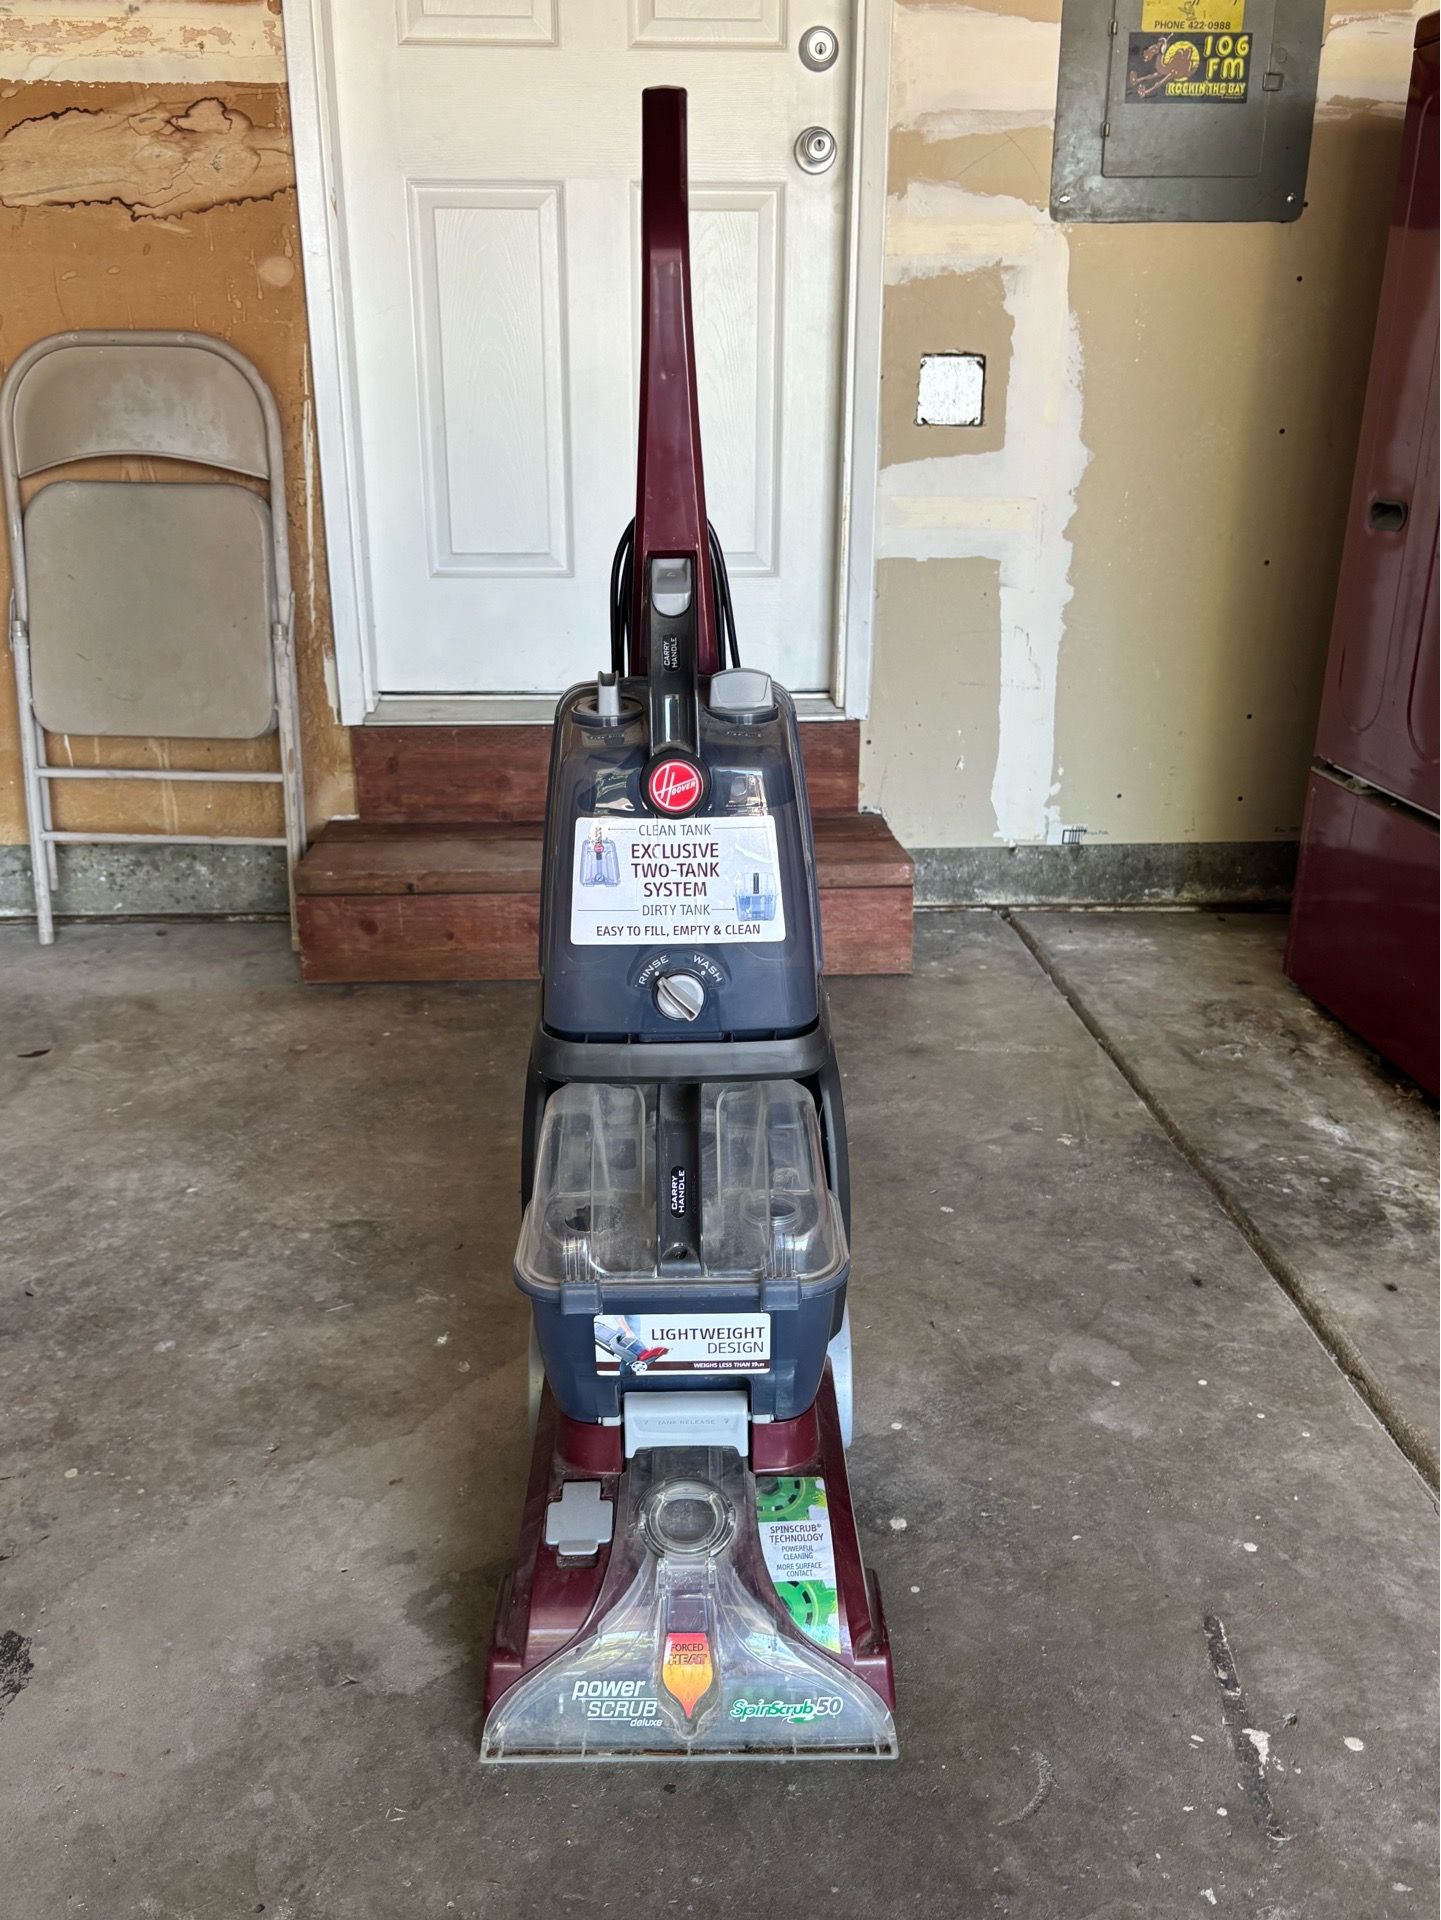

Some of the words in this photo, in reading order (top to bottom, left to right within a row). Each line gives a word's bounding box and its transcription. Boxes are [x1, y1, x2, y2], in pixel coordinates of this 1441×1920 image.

[1154, 20, 1185, 29] PHONE
[1188, 20, 1231, 30] 422-0988
[1203, 35, 1249, 57] 106
[1206, 58, 1245, 80] FM
[1227, 82, 1246, 96] BAY
[663, 641, 671, 666] CARRY
[670, 637, 678, 668] HANDLE
[638, 824, 676, 836] CLEAN
[682, 824, 711, 836] TANK
[631, 843, 719, 859] EXCLUSIVE
[631, 863, 720, 878] TWO-TANK
[643, 882, 707, 897] SYSTEM
[642, 905, 676, 916] DIRTY
[679, 904, 711, 916] TANK
[596, 926, 623, 937] EASY
[627, 926, 641, 936] TO
[644, 926, 670, 938] FILL,
[673, 925, 710, 936] EMPTY
[713, 925, 722, 935] &
[725, 924, 761, 935] CLEAN
[638, 955, 669, 985] RINSE
[693, 954, 722, 983] WASH
[651, 1327, 766, 1341] LIGHTWEIGHT
[707, 1342, 764, 1354] DESIGN
[769, 1533, 823, 1543] TECHNOLOGY
[783, 1552, 813, 1560] CLEANING
[786, 1569, 813, 1577] CONTACT
[671, 1643, 704, 1652] FORCED
[668, 1653, 707, 1665] HEAT
[572, 1679, 646, 1700] power
[587, 1701, 657, 1717] SCRUB
[630, 1717, 662, 1727] deluxe
